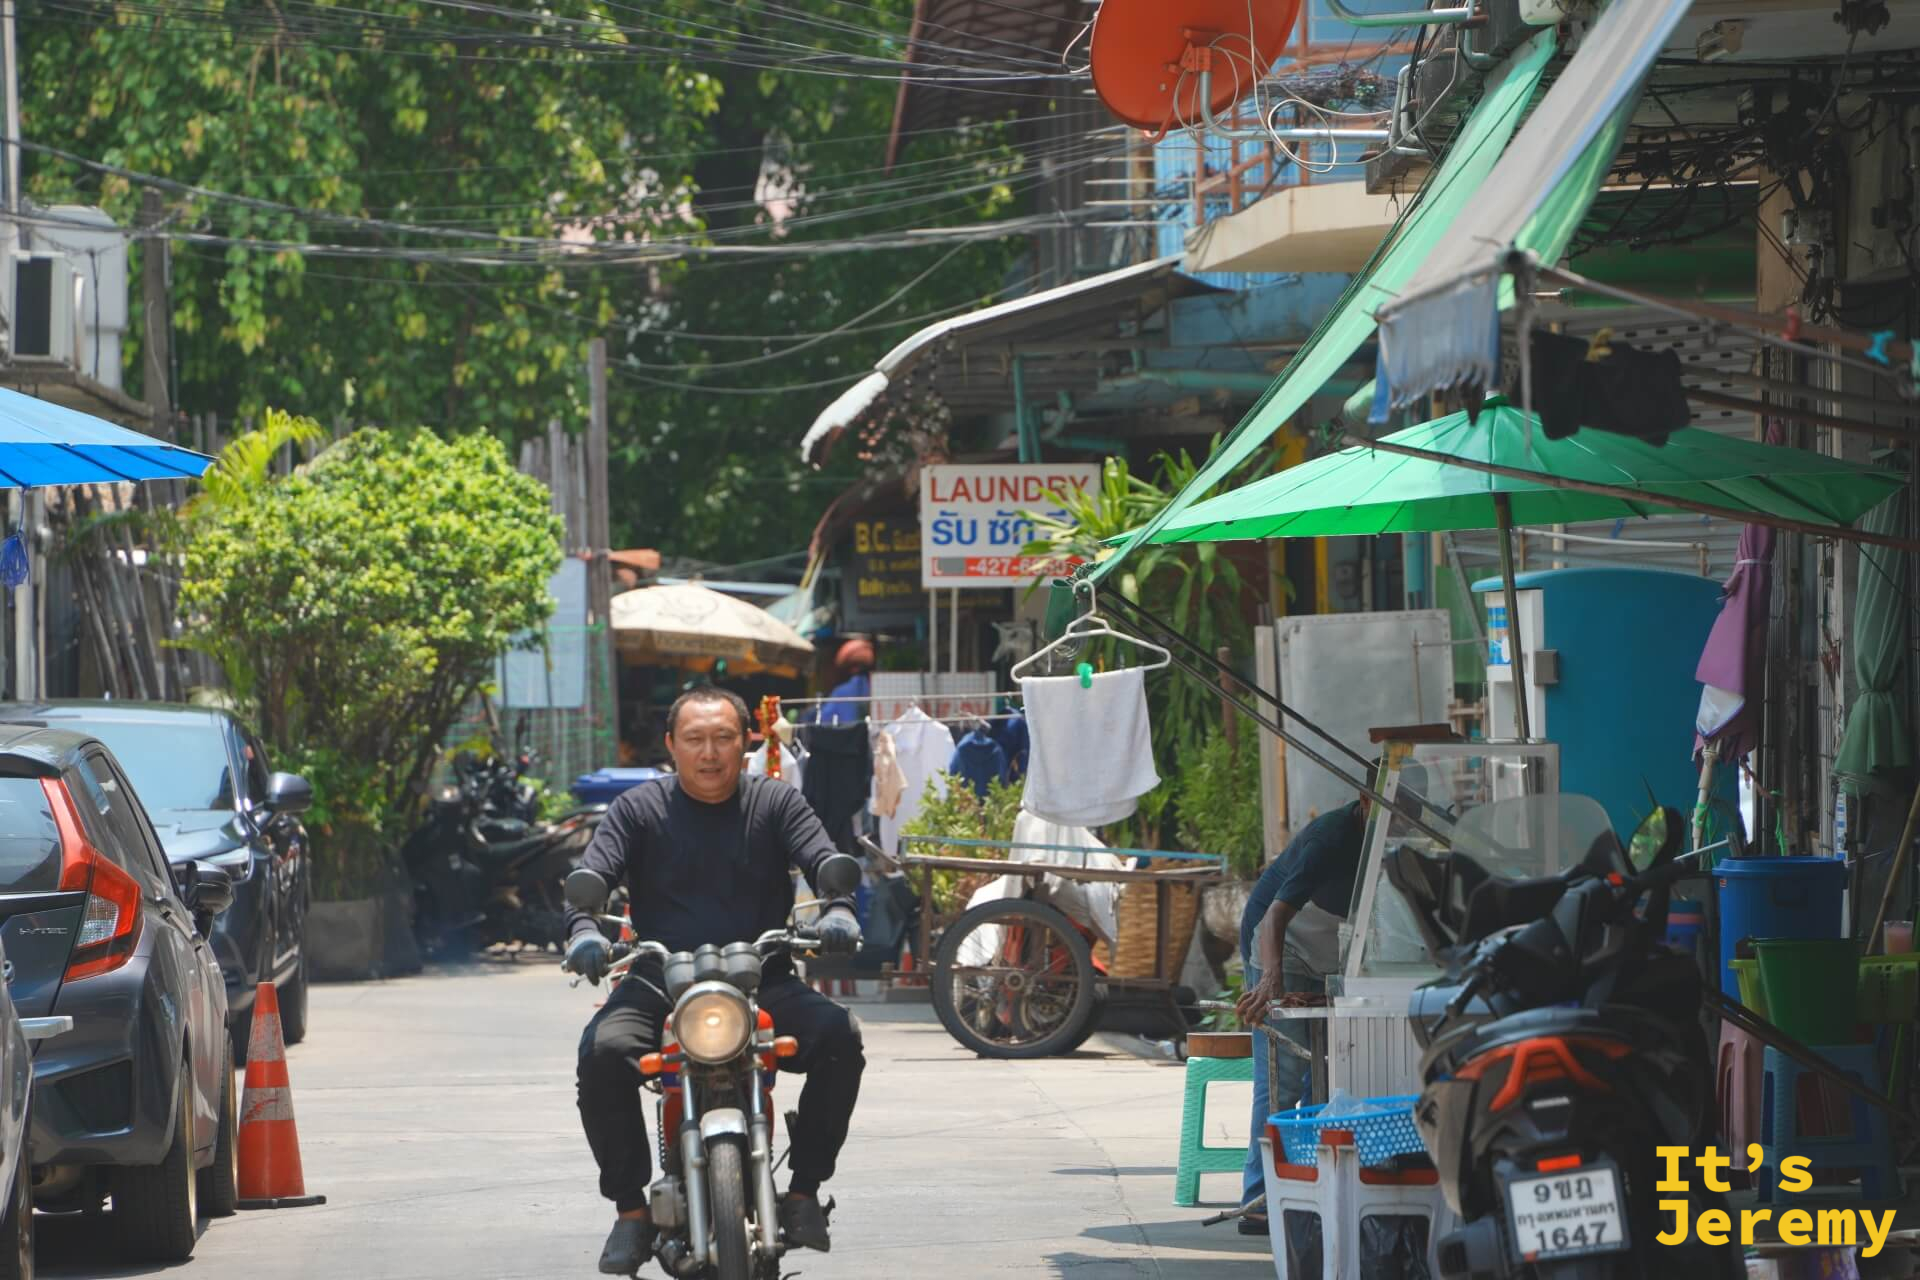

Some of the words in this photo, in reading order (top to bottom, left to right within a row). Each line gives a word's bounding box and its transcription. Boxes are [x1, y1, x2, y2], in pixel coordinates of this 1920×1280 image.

[930, 474, 1089, 503] LAUNDRY
[931, 509, 977, 545] รับ
[1535, 1220, 1608, 1252] 1647
